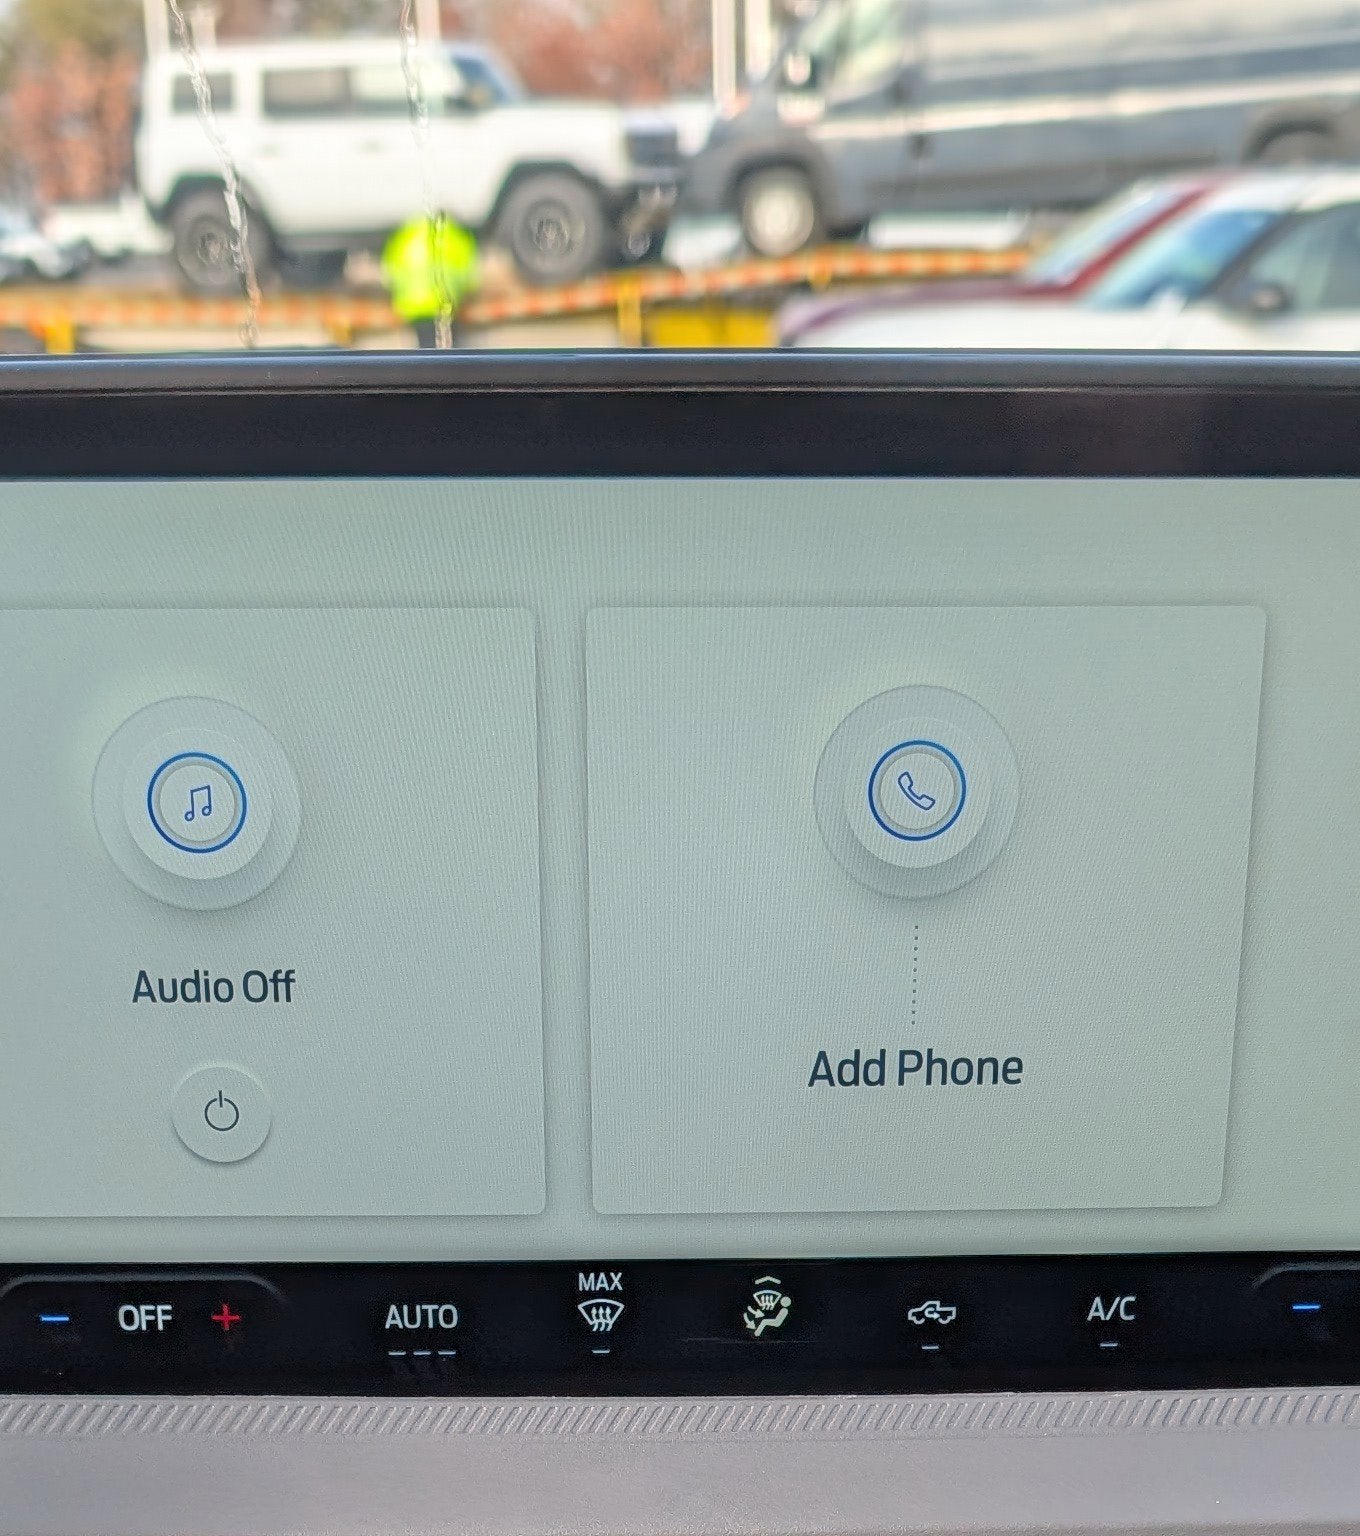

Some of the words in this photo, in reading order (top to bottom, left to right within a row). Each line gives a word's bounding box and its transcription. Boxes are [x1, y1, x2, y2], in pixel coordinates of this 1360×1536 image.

[131, 969, 235, 1004] Audio
[241, 969, 297, 1004] Off
[807, 1050, 888, 1088] Add
[897, 1049, 1025, 1087] Phone
[577, 1271, 624, 1292] MAX
[117, 1303, 173, 1333] OFF
[384, 1303, 459, 1331] AUTO
[1086, 1294, 1138, 1324] A/C
